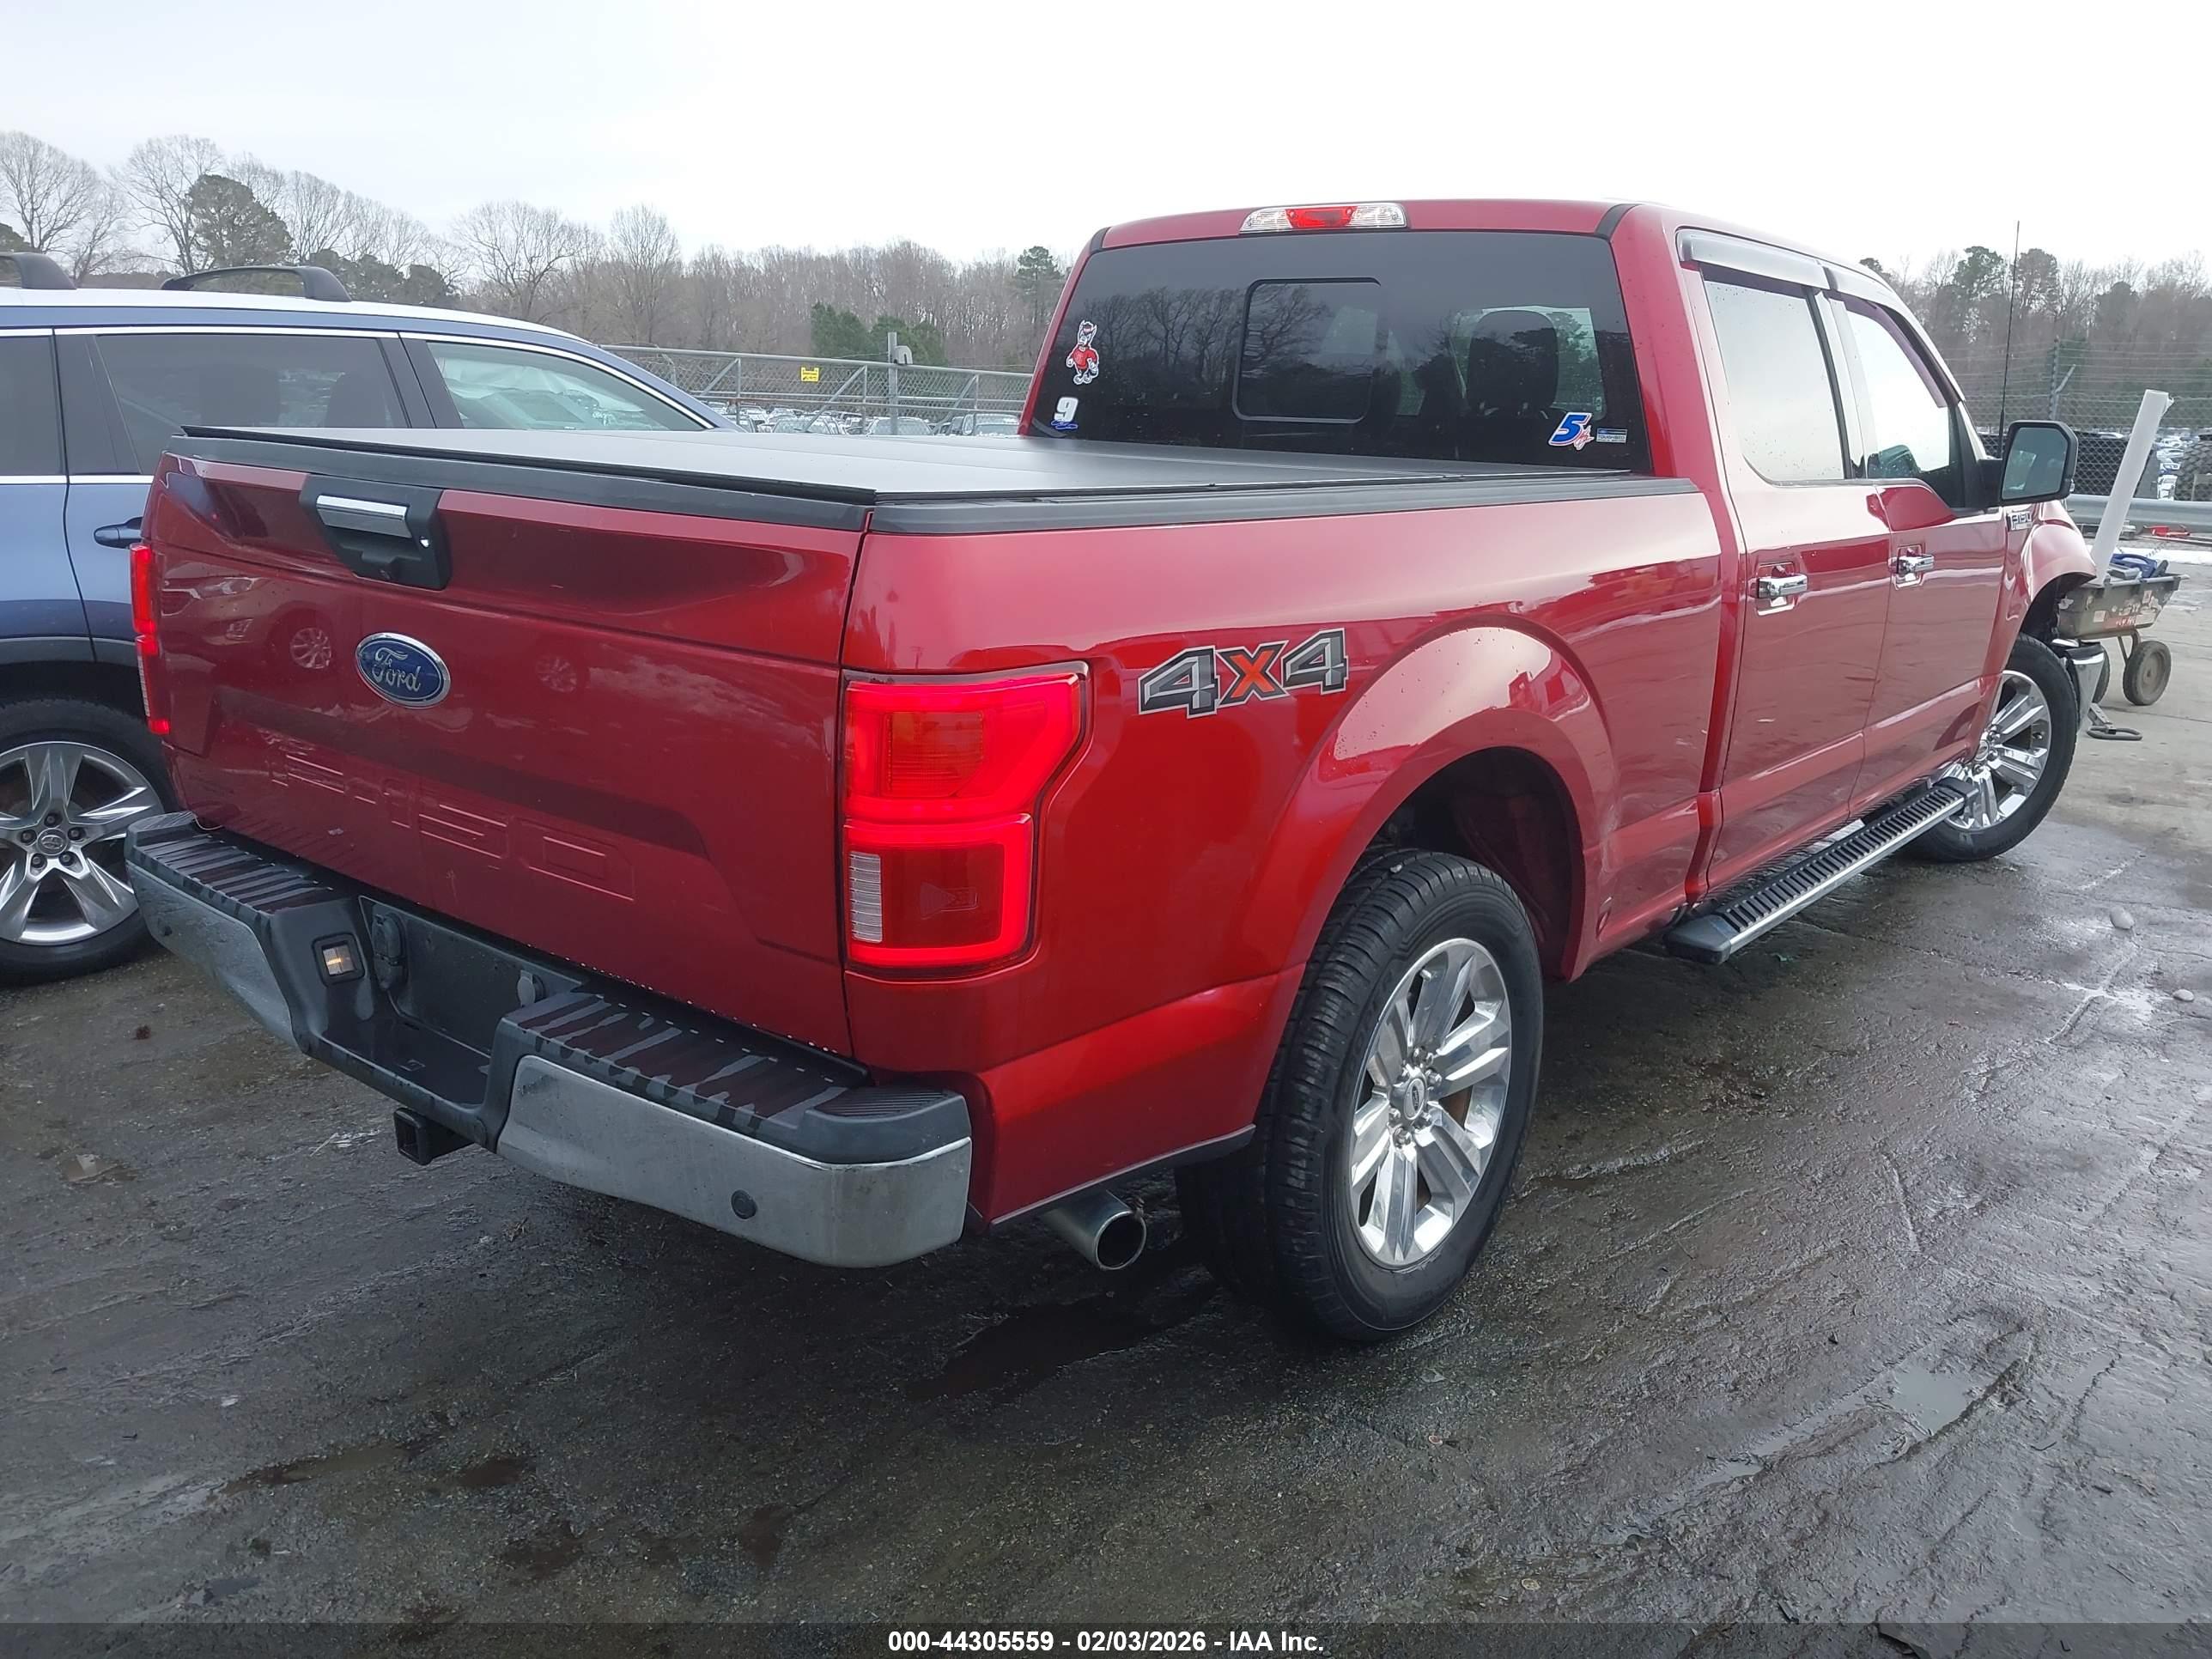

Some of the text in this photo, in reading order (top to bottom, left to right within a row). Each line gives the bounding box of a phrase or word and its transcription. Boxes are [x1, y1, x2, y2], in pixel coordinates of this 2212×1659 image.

[1054, 397, 1079, 422] 9
[1549, 412, 1592, 446] 5
[371, 647, 422, 692] Ford
